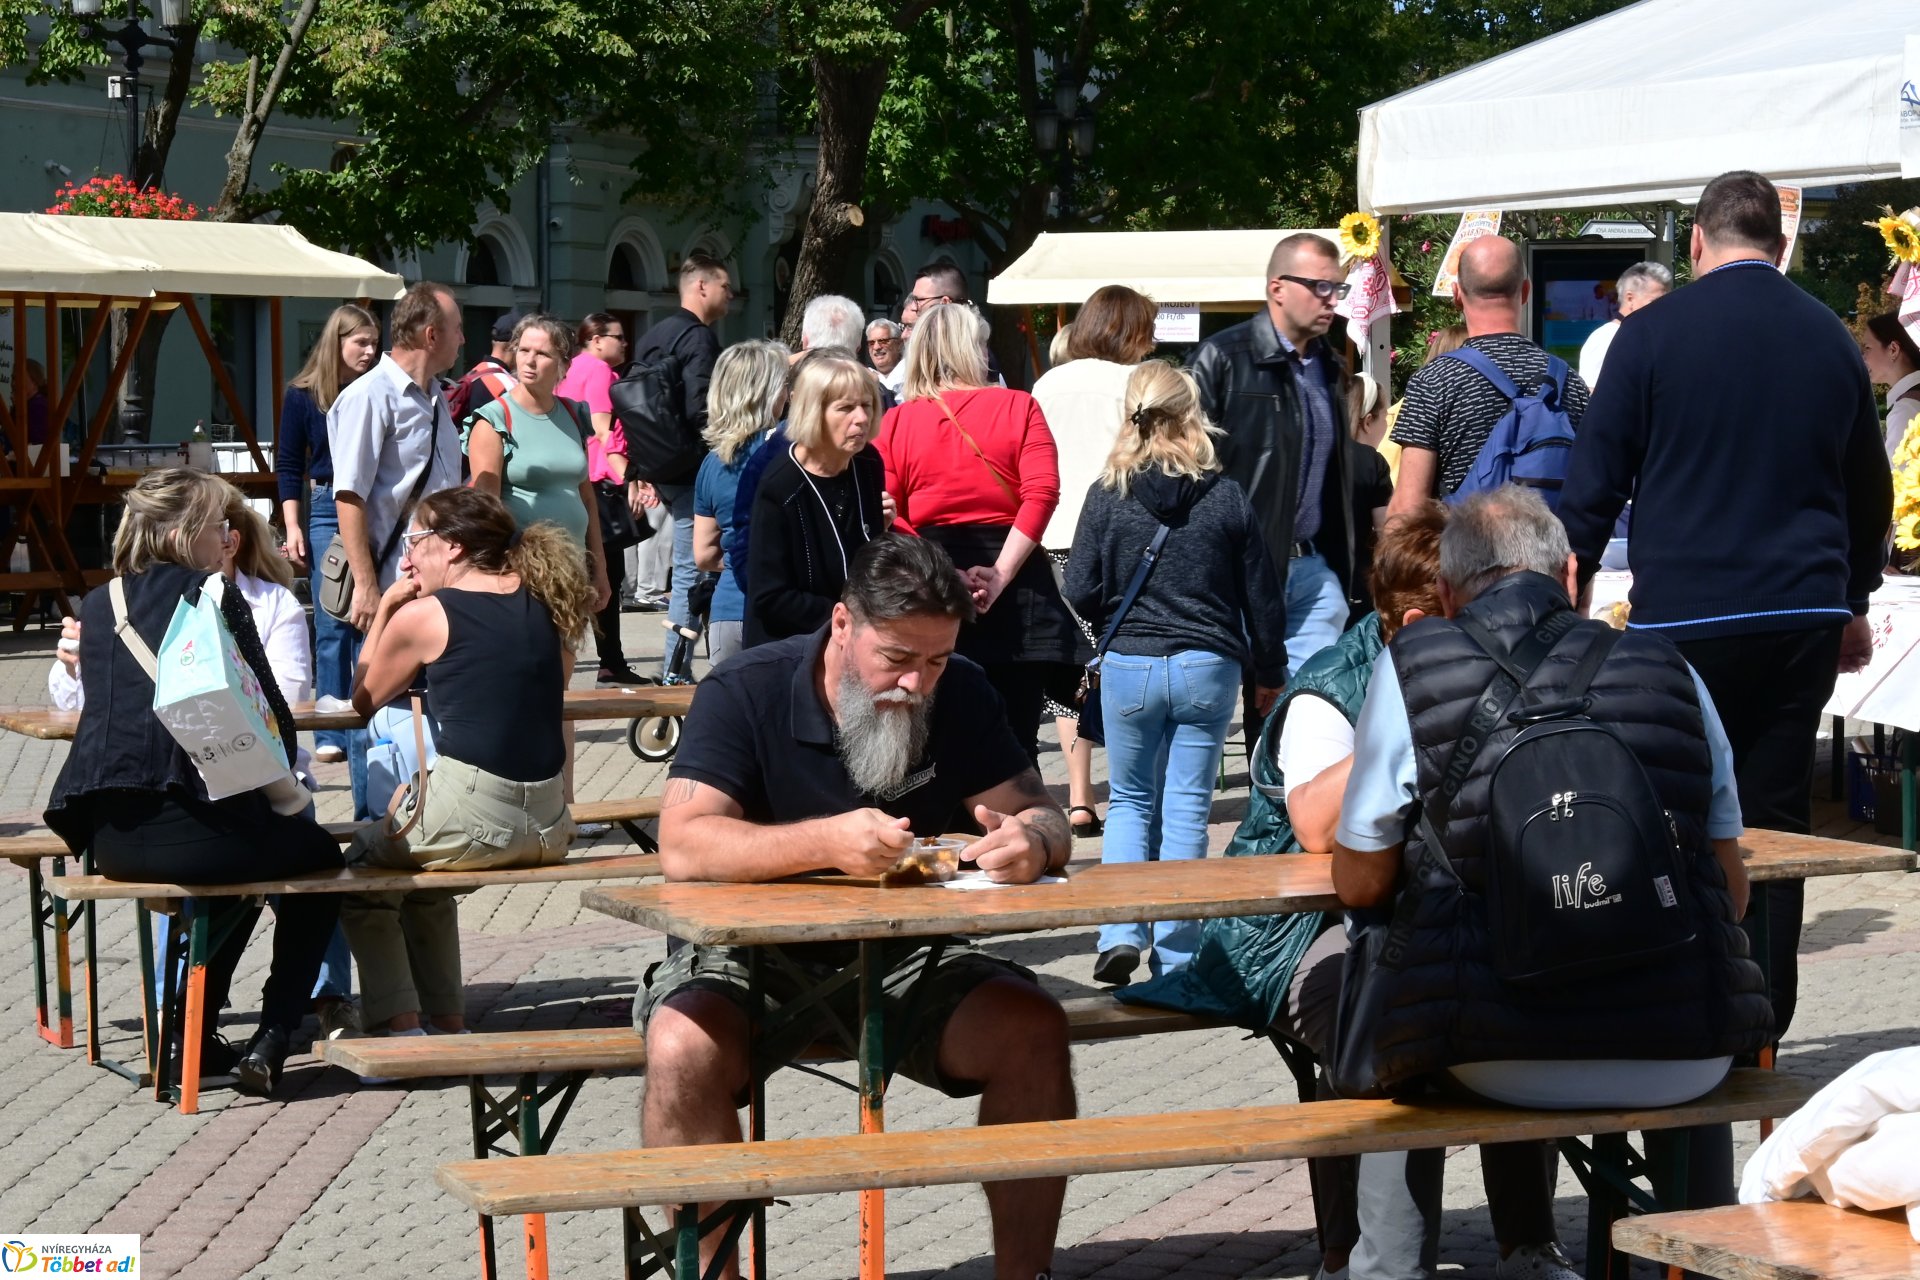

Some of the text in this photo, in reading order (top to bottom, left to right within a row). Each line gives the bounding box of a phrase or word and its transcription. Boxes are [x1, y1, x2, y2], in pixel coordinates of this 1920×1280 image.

[1166, 312, 1185, 320] Ft/db
[1535, 612, 1574, 645] GINO
[1442, 735, 1478, 797] GINO
[1552, 861, 1607, 909] life
